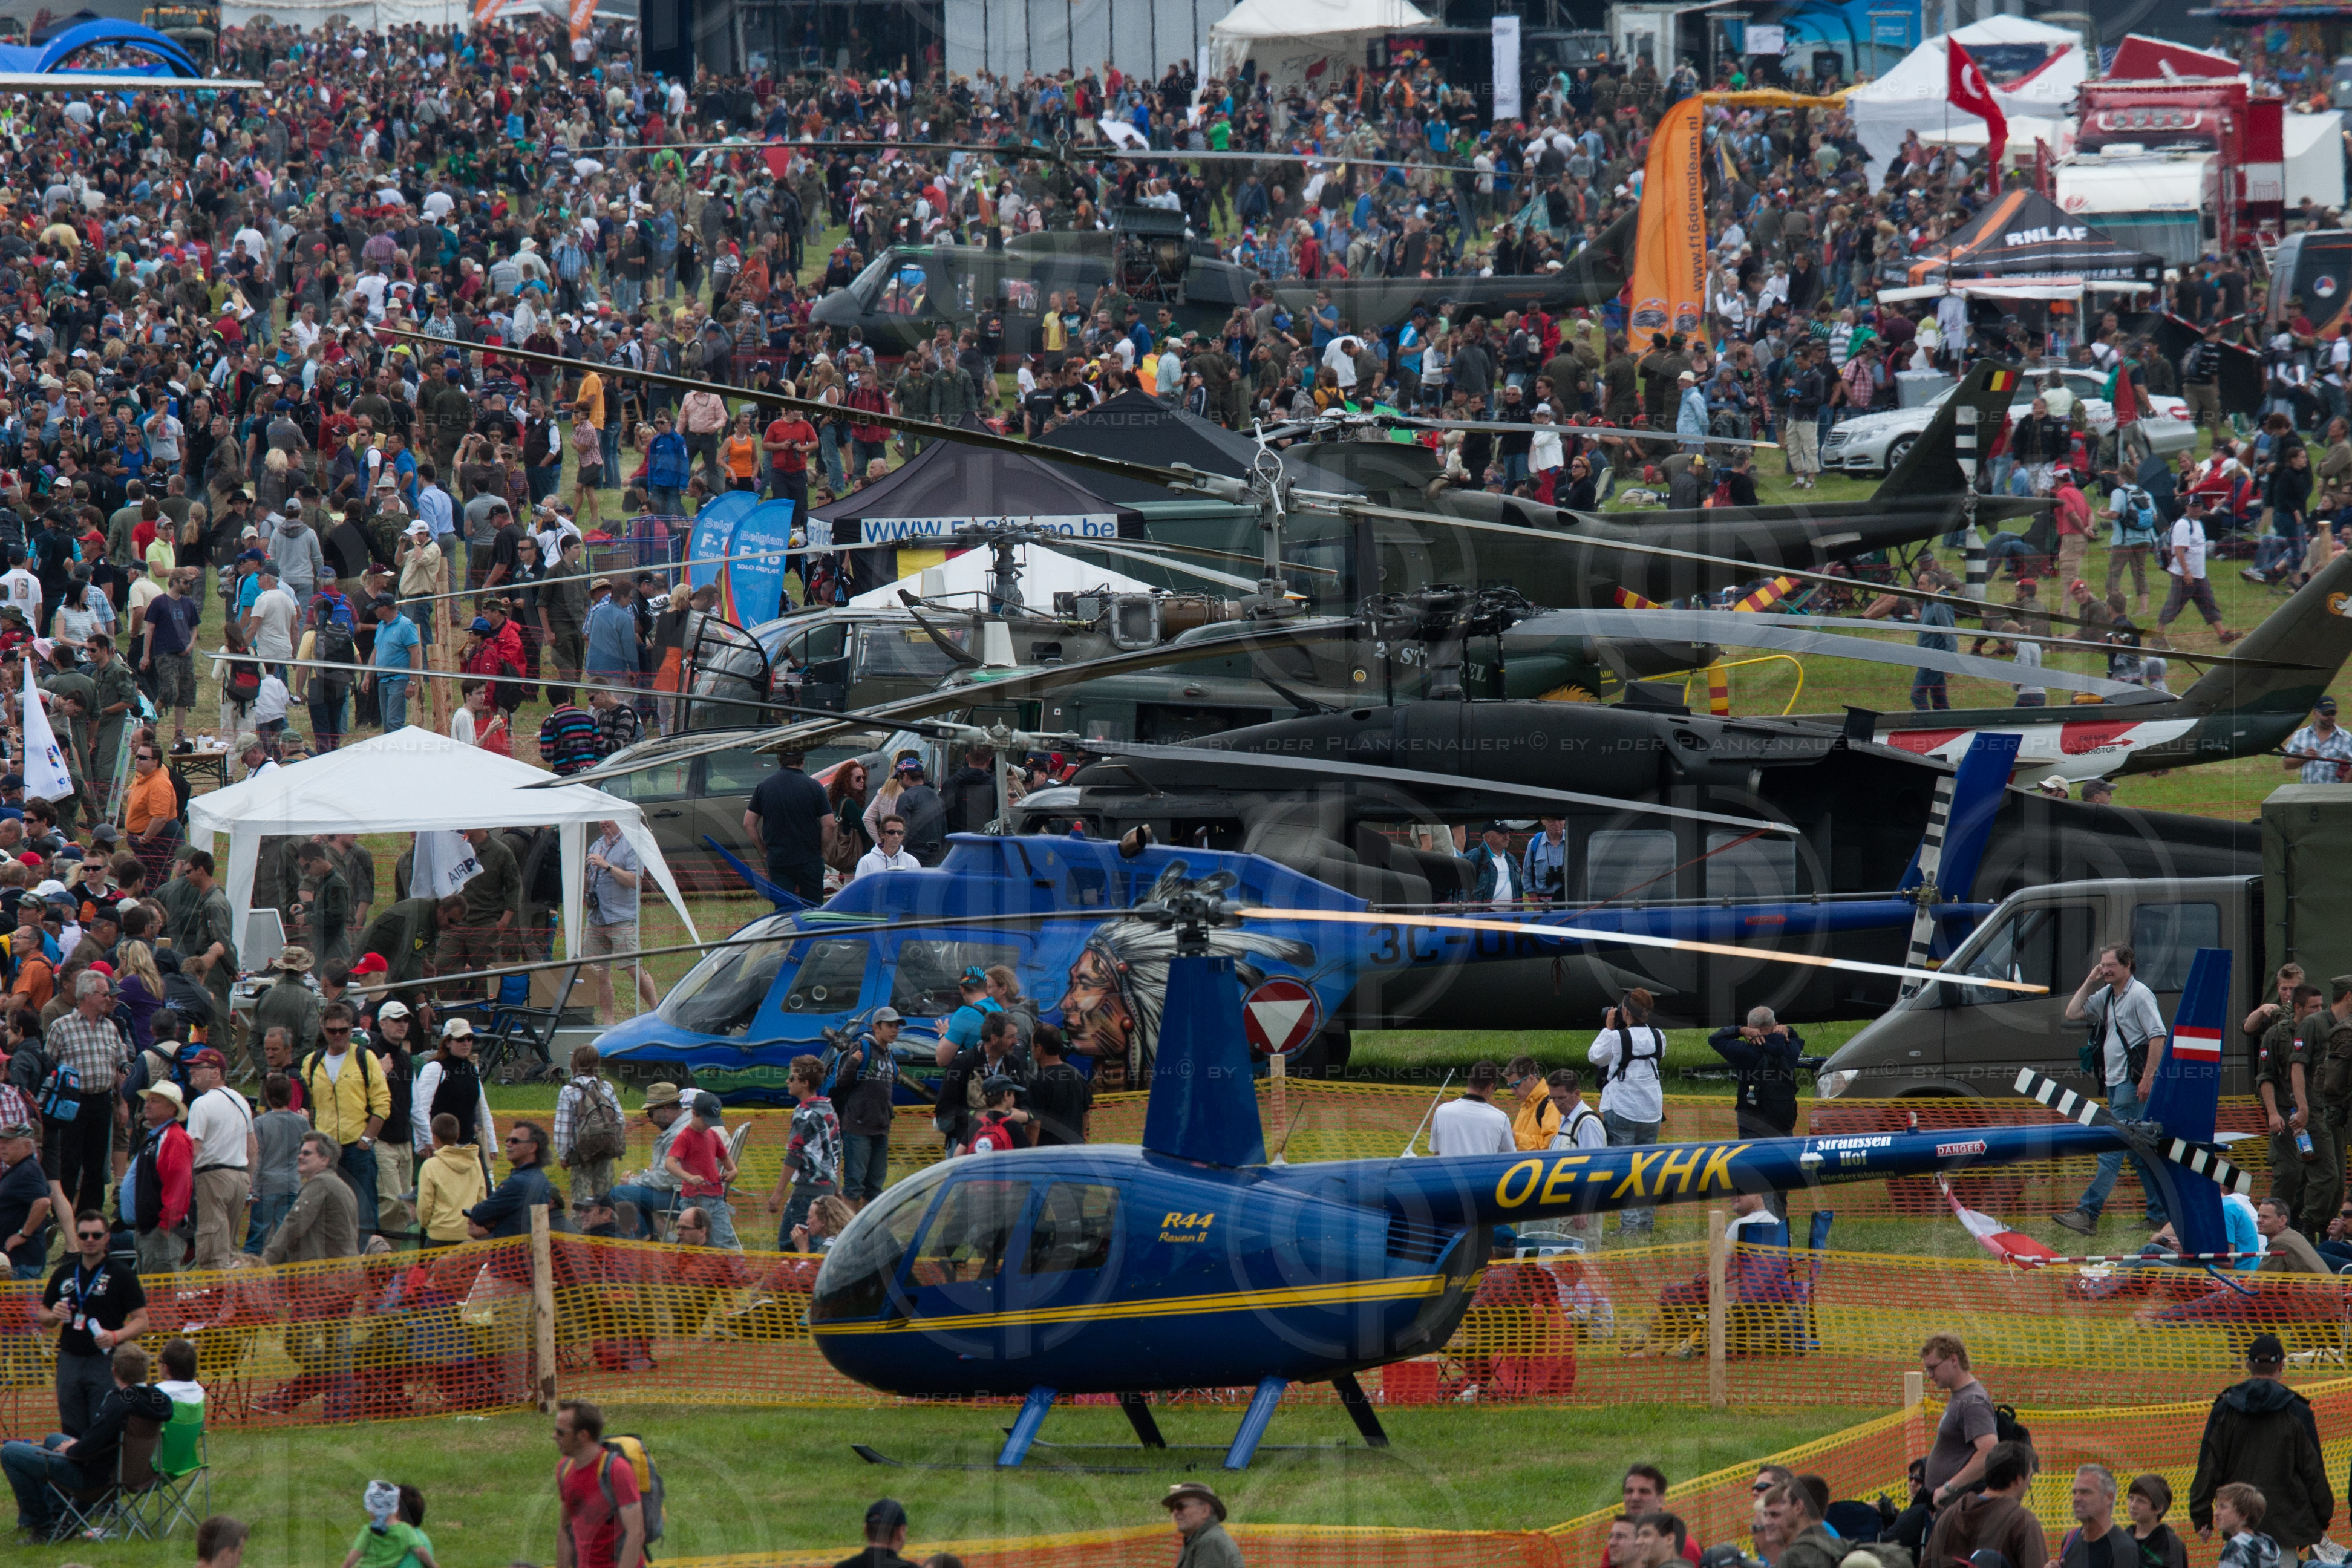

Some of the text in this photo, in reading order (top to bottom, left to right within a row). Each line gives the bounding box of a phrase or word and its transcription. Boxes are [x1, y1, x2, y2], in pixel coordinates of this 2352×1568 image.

[1686, 116, 1704, 292] www.f16demoteam.nl
[2005, 225, 2087, 246] RNLAF
[704, 517, 734, 533] Belgi
[701, 532, 729, 551] F-1
[740, 530, 783, 546] Belgian
[756, 566, 780, 574] DISPLAY
[172, 610, 184, 620] 19
[2079, 733, 2109, 742] GEFAHR
[2071, 746, 2117, 756] HECKROTOR
[448, 857, 475, 885] AIRP
[1840, 1149, 1867, 1166] Hof
[1937, 1143, 1982, 1157] DANGER
[1495, 1143, 1754, 1209] OE-XHK
[1161, 1212, 1215, 1229] R44
[1158, 1232, 1195, 1243] Raven
